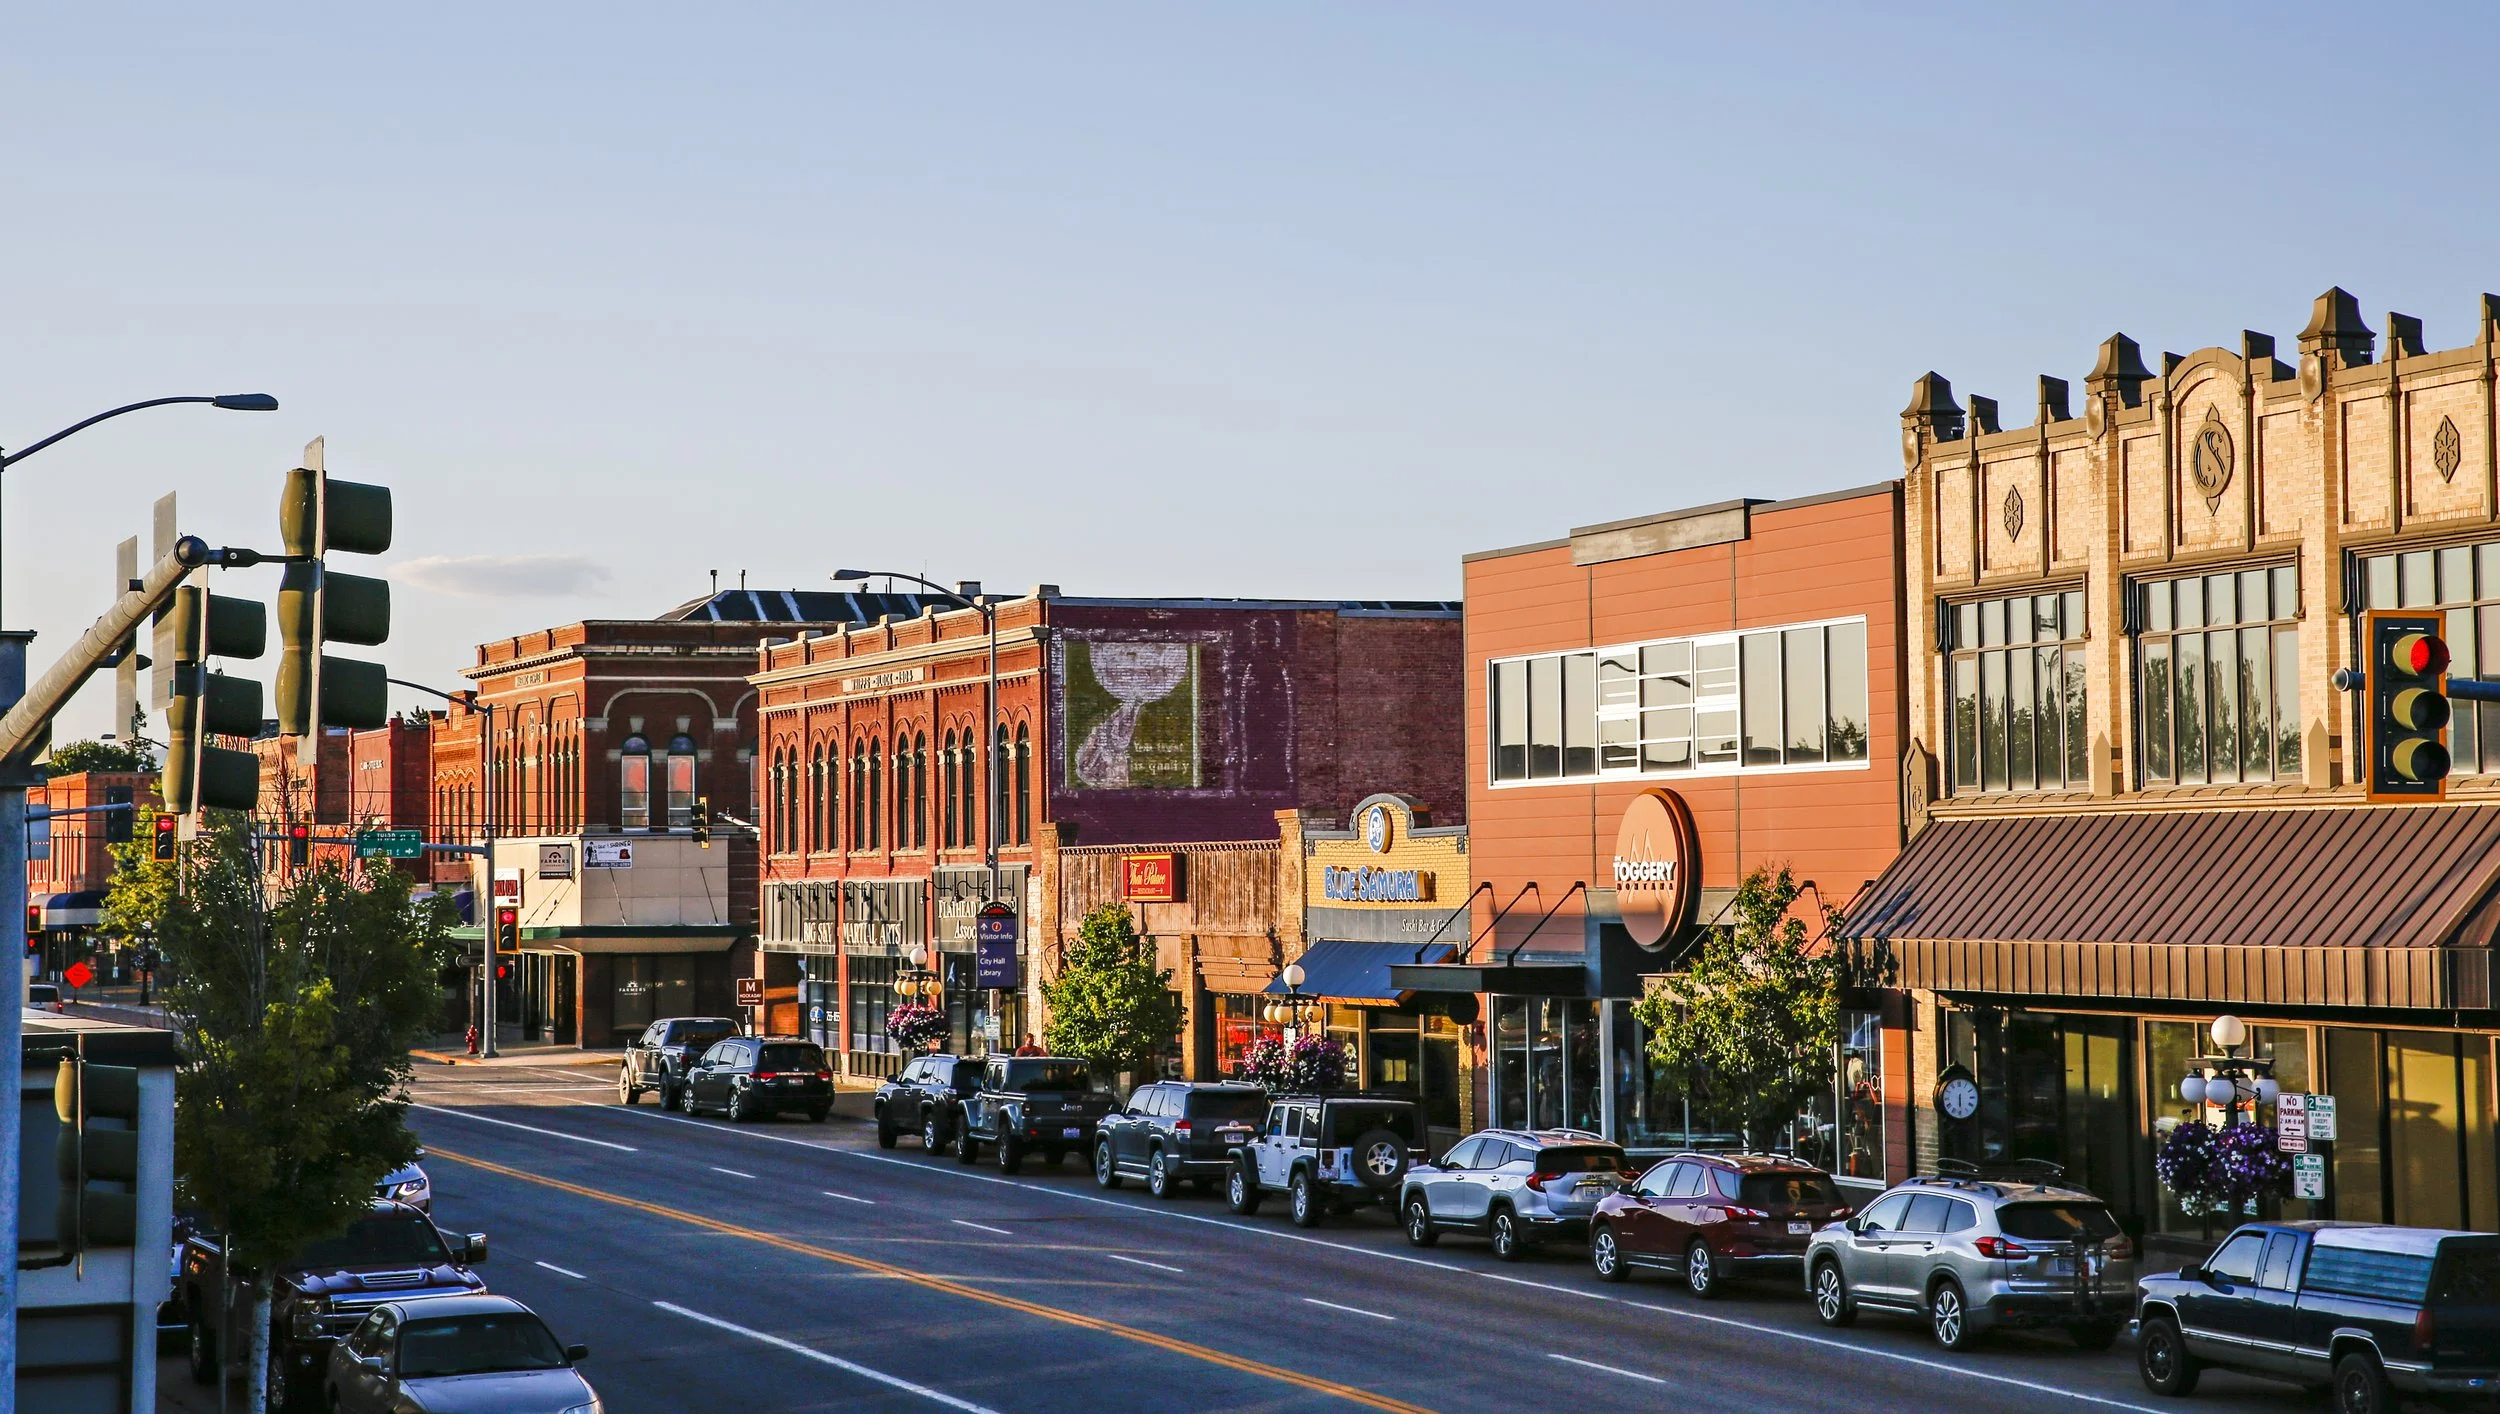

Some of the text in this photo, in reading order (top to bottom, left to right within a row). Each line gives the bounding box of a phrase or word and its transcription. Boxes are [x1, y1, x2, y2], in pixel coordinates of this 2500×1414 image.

[876, 673, 894, 688] BLOCK
[1148, 760, 1190, 775] qualiy
[1129, 861, 1166, 885] Thai Palace
[1613, 862, 1676, 881] TOGGERY
[1324, 865, 1420, 901] BLUE SAMURAI
[1616, 882, 1674, 890] MONTANA
[938, 899, 977, 918] FLATHEAD
[1401, 918, 1418, 933] Sushi
[1418, 918, 1430, 933] Bar
[1430, 920, 1437, 932] &
[803, 921, 901, 945] BIG SKY MARTIAL ARTS
[980, 957, 1006, 966] City Hall
[980, 969, 1001, 977] Library
[746, 981, 756, 992] M
[1061, 1103, 1083, 1112] Jeep
[2286, 1097, 2297, 1106] NO
[2308, 1097, 2315, 1109] 2
[2280, 1108, 2304, 1117] PARKING
[2296, 1158, 2303, 1167] 30
